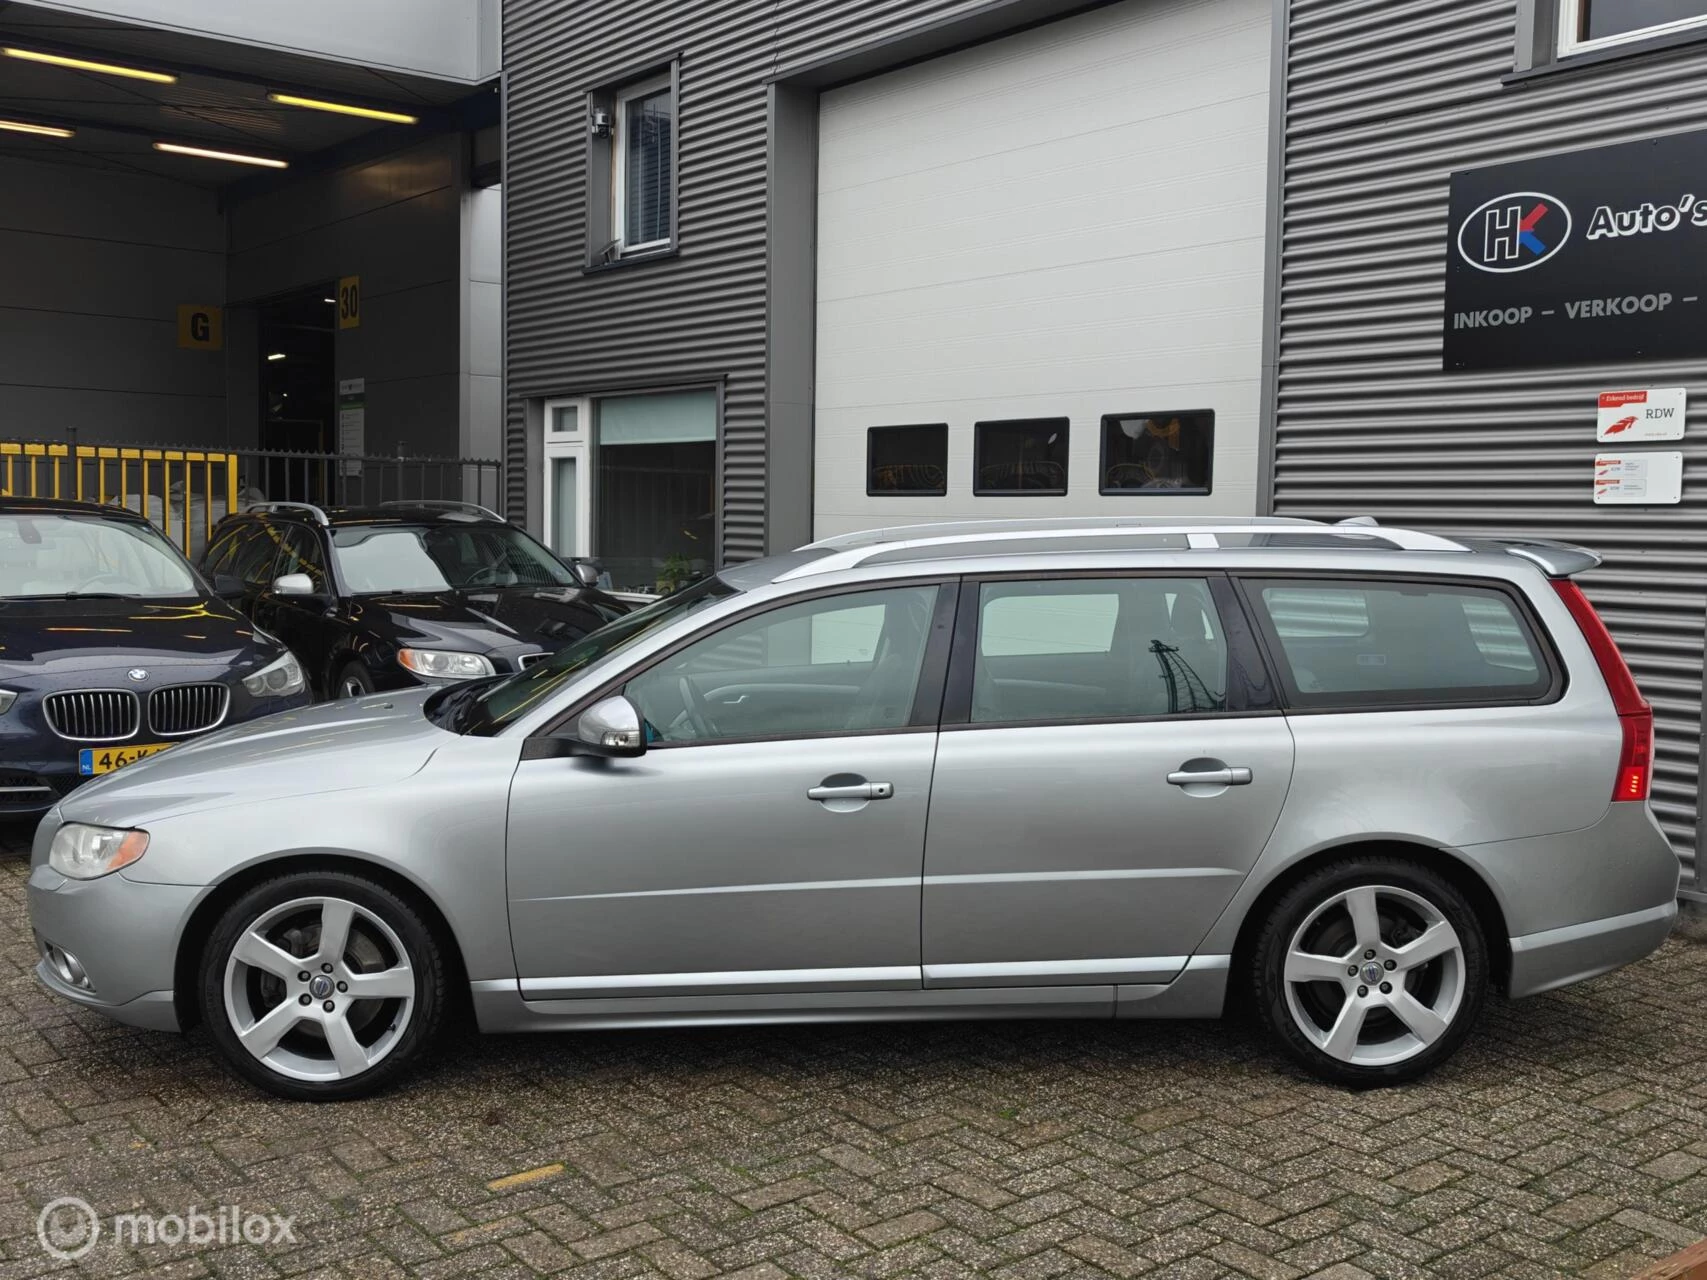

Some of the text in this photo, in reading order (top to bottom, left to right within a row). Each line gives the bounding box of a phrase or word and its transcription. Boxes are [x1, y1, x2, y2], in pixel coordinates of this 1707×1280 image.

[1586, 193, 1707, 240] Auto's
[340, 284, 358, 319] 30
[1453, 306, 1533, 329] INKOOP
[1564, 292, 1673, 319] VERKOOP
[191, 312, 210, 342] G
[1645, 408, 1675, 419] RDW
[98, 748, 161, 770] 46-K
